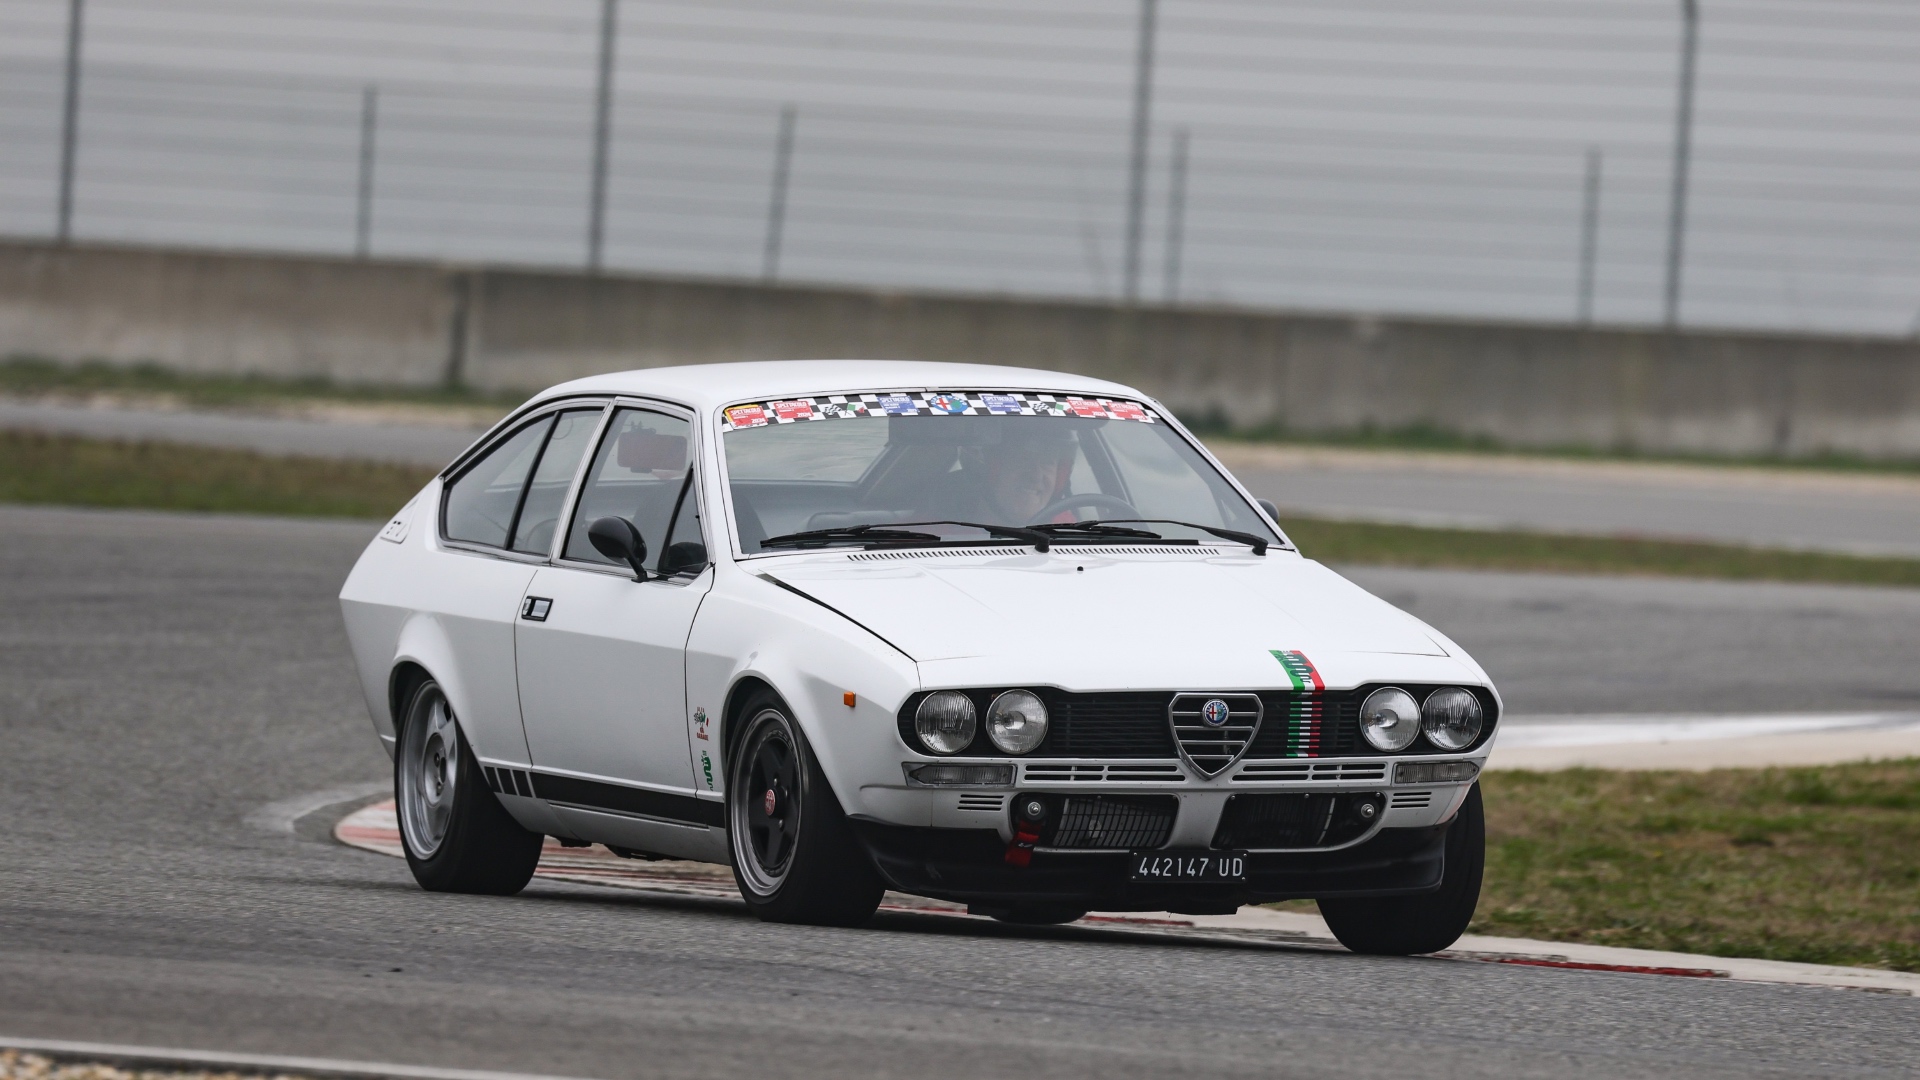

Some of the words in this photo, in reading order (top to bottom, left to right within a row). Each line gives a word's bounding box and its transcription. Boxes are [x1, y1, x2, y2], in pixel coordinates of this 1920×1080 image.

[730, 407, 761, 415] SPETTACOLO
[1139, 857, 1209, 876] 442147
[1219, 858, 1243, 877] UD
